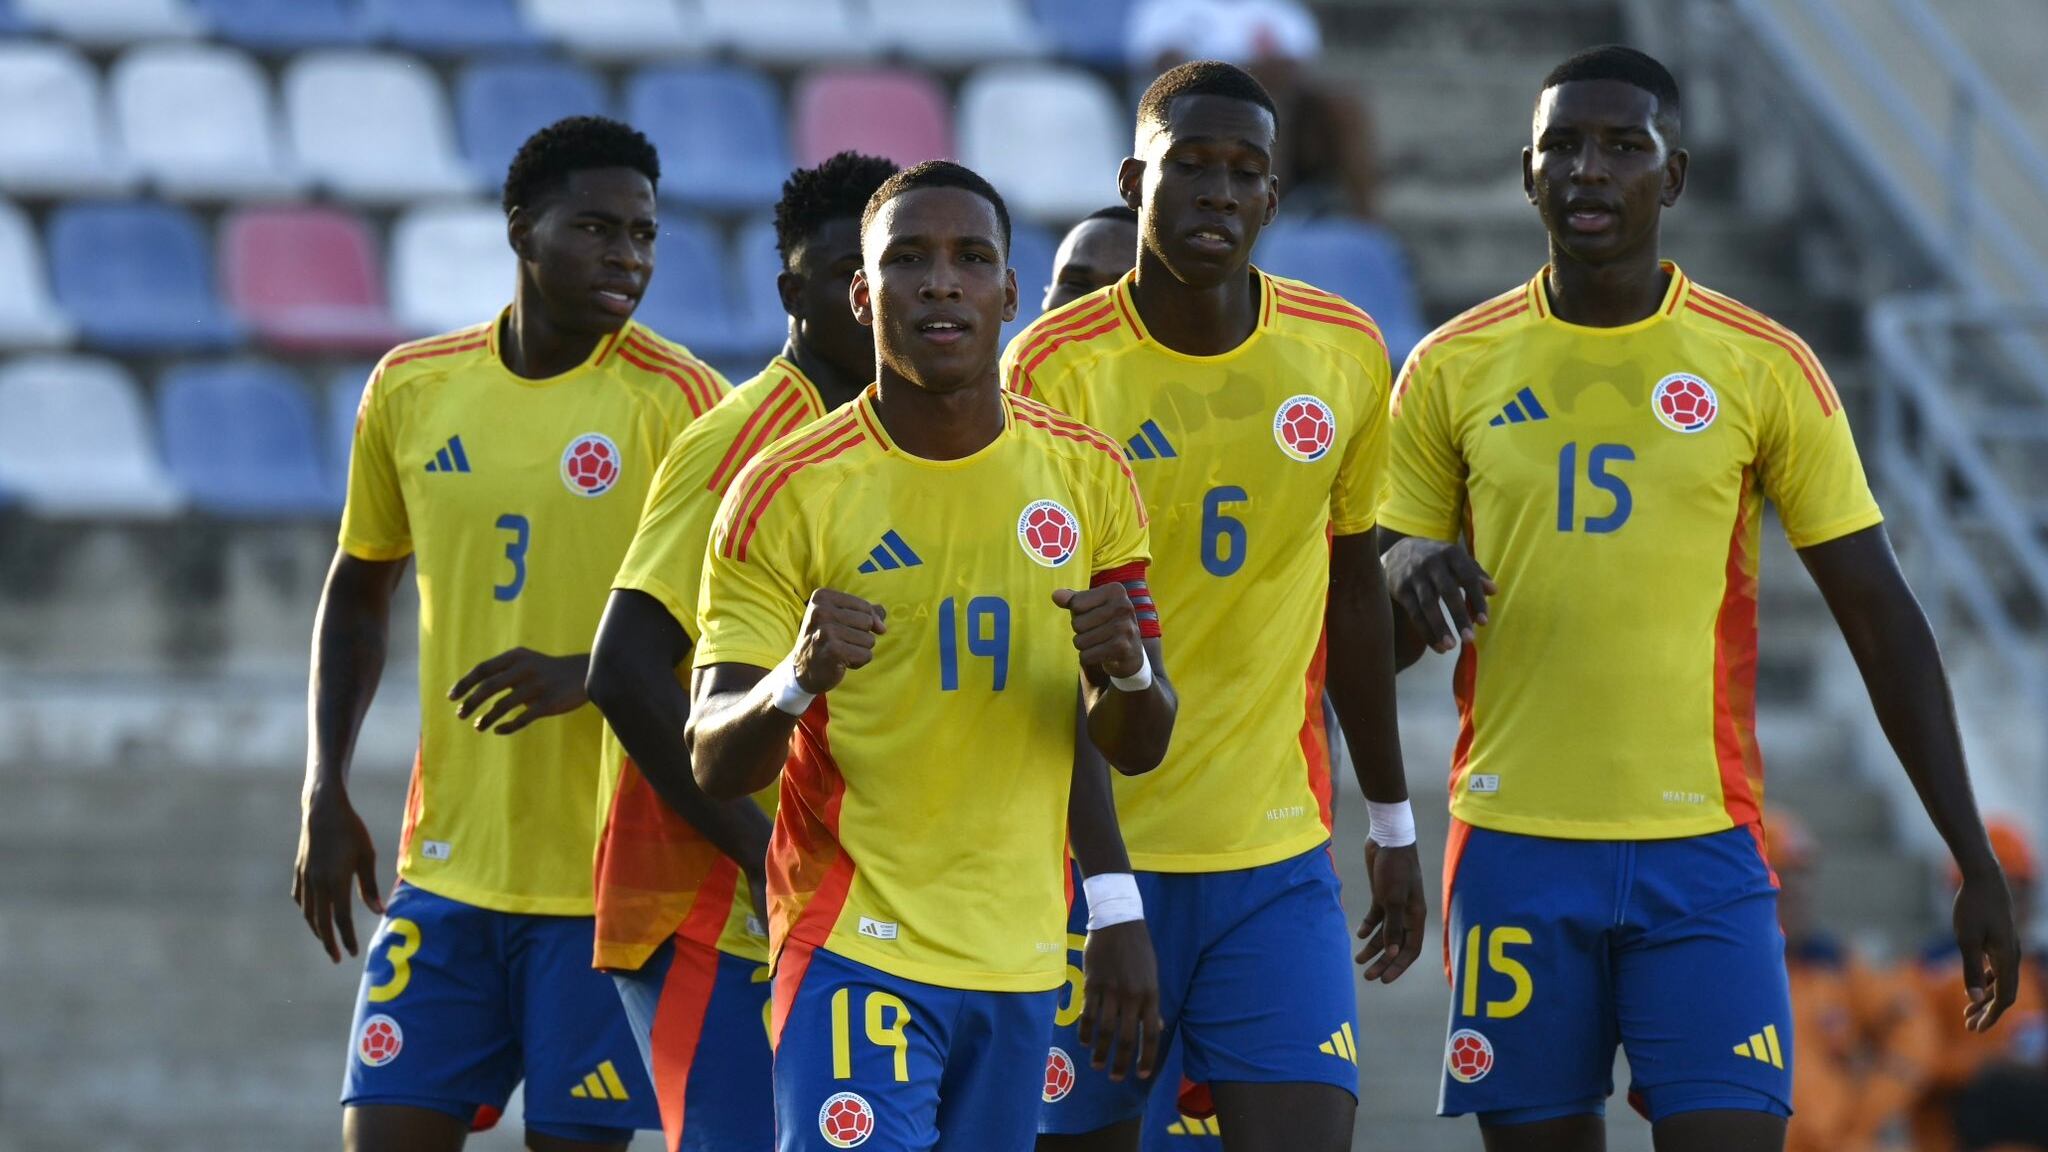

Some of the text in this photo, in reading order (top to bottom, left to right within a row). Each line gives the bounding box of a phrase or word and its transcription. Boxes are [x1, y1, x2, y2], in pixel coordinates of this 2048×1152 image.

[1202, 487, 1247, 577] 6
[1557, 442, 1635, 534] 15
[494, 514, 529, 602] 3
[938, 596, 1010, 691] 19
[367, 918, 422, 1003] 3
[1461, 926, 1534, 1019] 15
[831, 988, 912, 1082] 19
